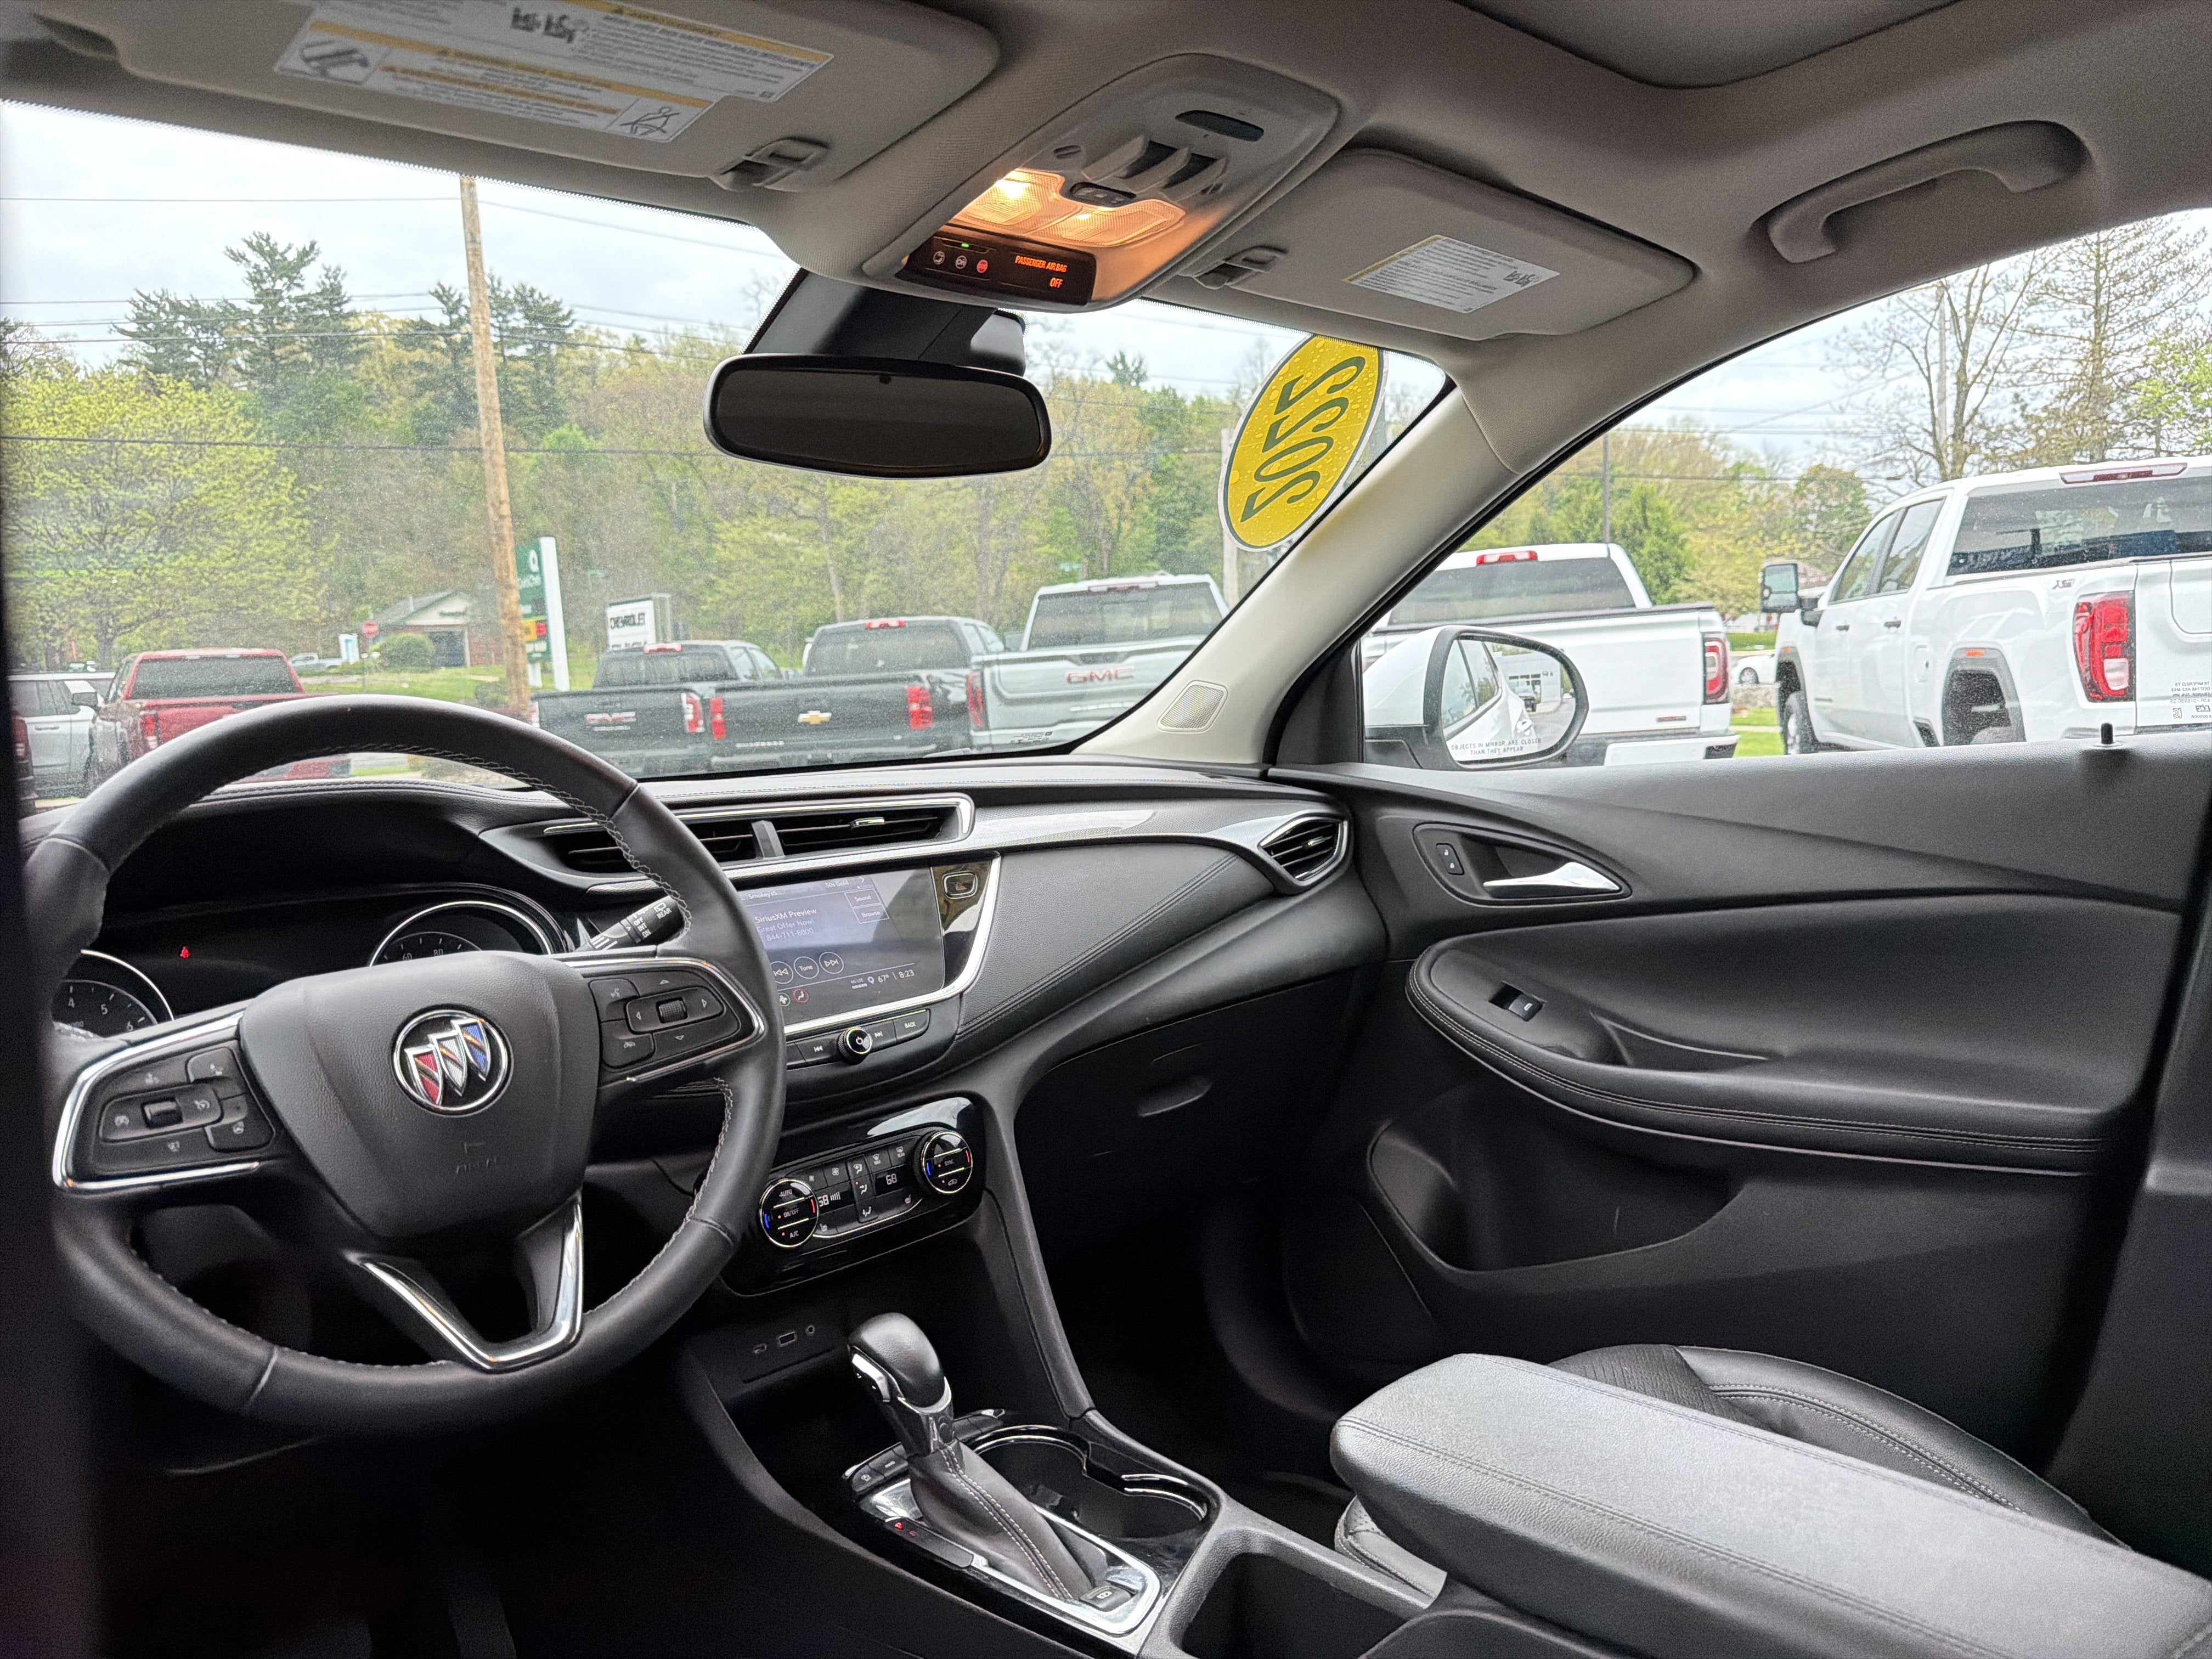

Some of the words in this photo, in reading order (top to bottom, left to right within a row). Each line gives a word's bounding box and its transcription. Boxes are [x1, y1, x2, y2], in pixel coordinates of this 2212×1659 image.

[1015, 256, 1046, 269] PASSENGER
[1050, 277, 1063, 288] OFF
[1066, 668, 1134, 685] GMC
[656, 908, 672, 919] REAR
[755, 912, 788, 923] SiriusXM
[788, 909, 817, 918] Preview
[633, 917, 644, 926] OFF
[637, 922, 647, 932] INT
[777, 922, 795, 930] Offer
[797, 918, 814, 926] Now!
[642, 929, 652, 938] ON
[403, 952, 413, 961] 60
[899, 969, 915, 979] 8:23
[68, 997, 75, 1008] 4
[101, 1003, 108, 1014] 5
[126, 1020, 133, 1031] 6
[885, 1173, 898, 1185] 68
[780, 1189, 793, 1197] AUTO
[783, 1209, 799, 1218] ON/OFF
